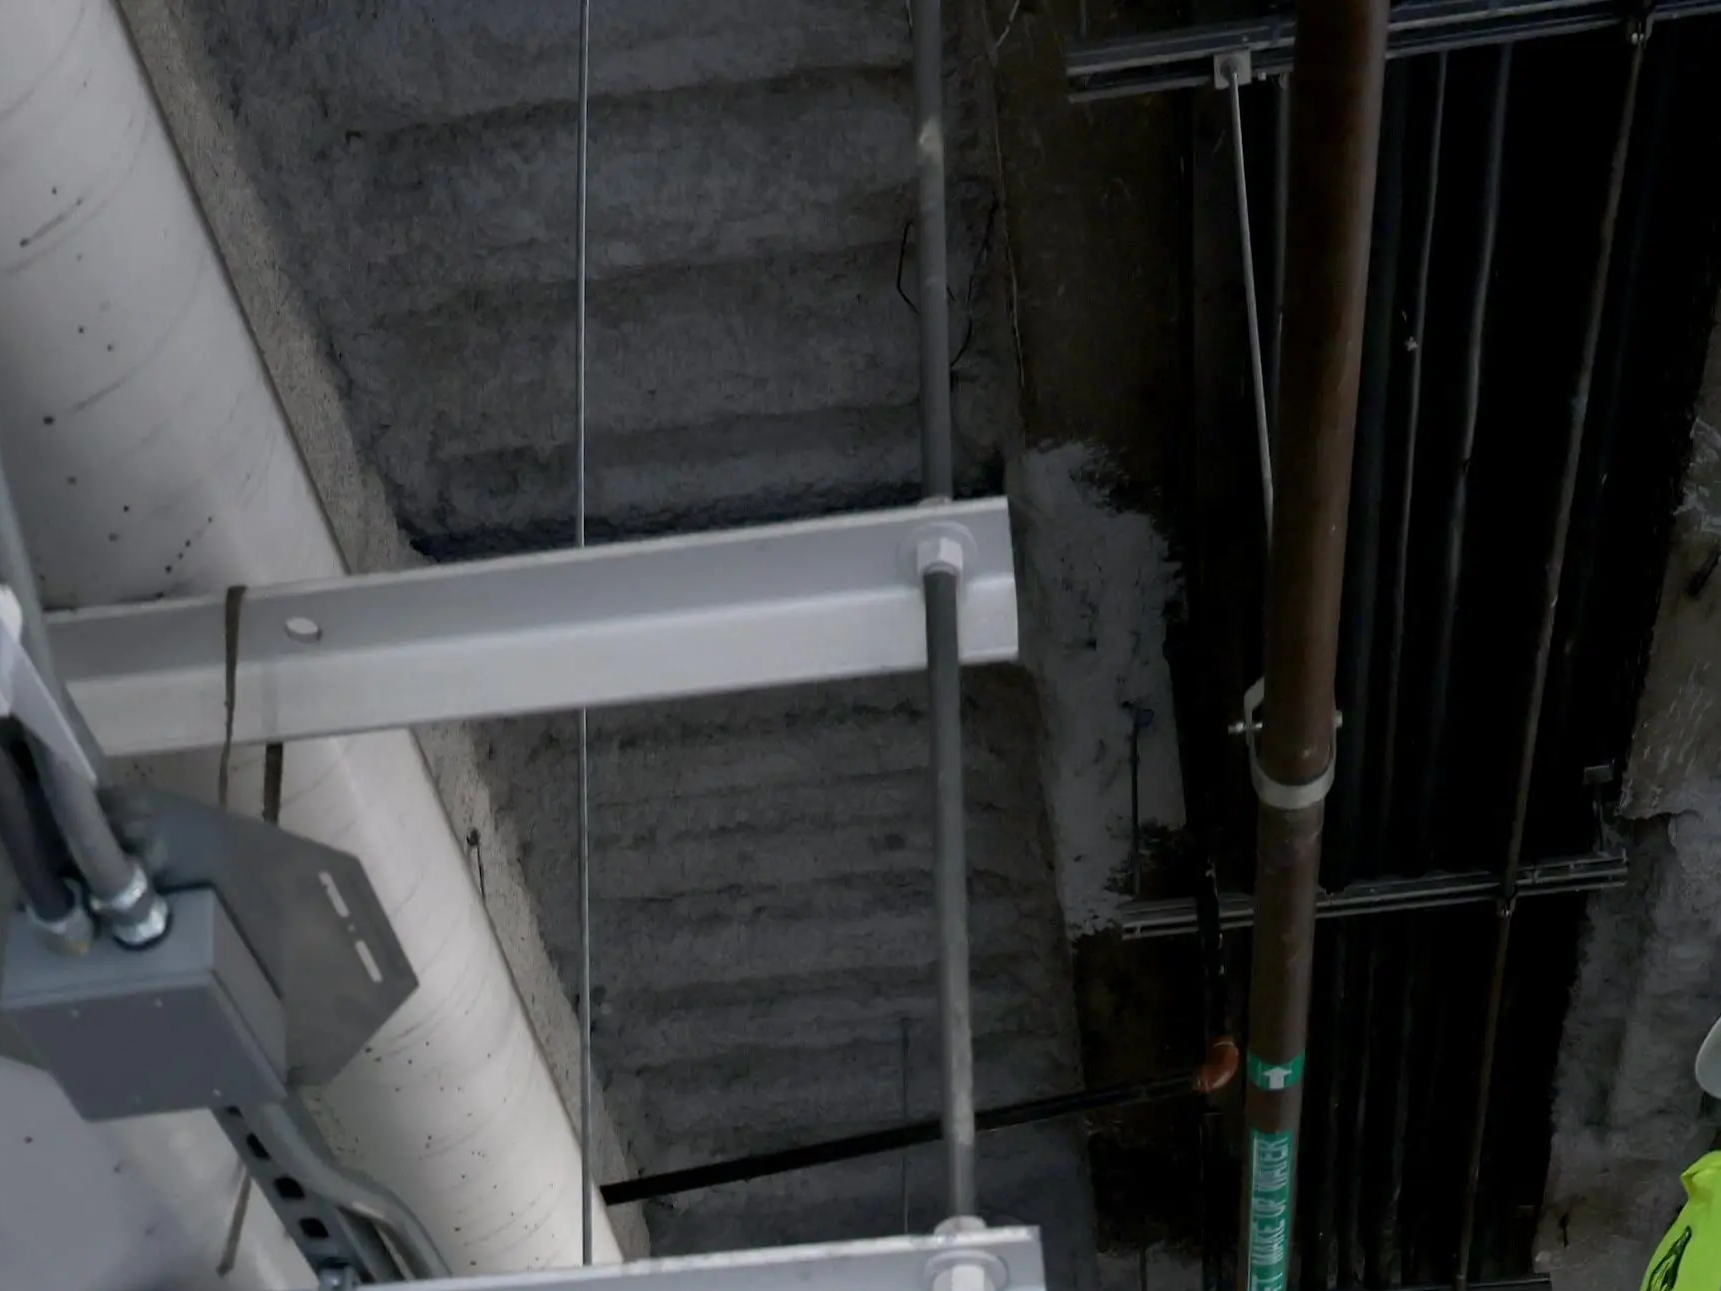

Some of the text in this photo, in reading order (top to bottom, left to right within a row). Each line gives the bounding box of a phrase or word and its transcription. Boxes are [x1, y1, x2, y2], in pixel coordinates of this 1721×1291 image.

[1254, 1136, 1290, 1192] WATER
[1253, 1194, 1287, 1219] UP
[1251, 1217, 1286, 1265] MAKE
